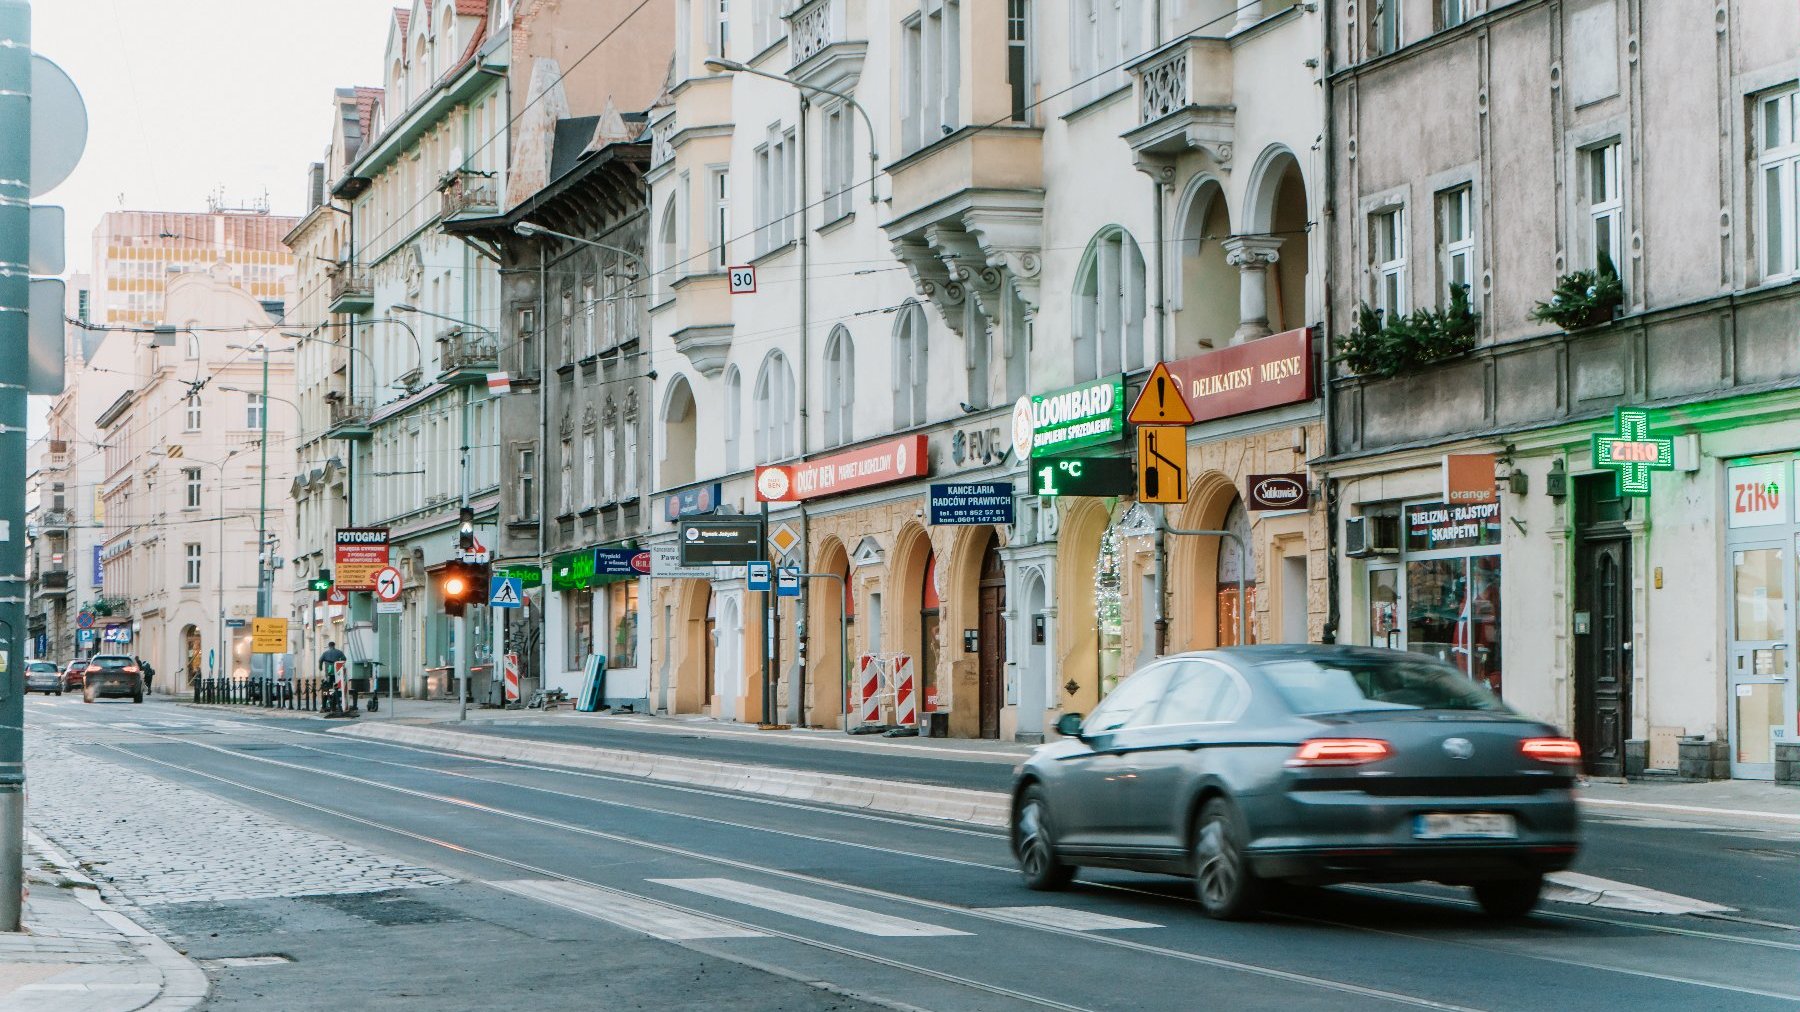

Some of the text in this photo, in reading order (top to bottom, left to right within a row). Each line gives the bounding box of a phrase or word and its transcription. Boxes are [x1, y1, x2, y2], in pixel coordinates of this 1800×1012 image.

[733, 273, 752, 287] 30
[1192, 356, 1301, 399] DELIKATESY MIĘSNE
[1033, 383, 1112, 429] LOOMBARD
[797, 464, 818, 493] DUŻY
[820, 464, 835, 488] BEN
[1039, 466, 1058, 495] 1
[947, 485, 995, 495] KANCELARIA
[1450, 489, 1491, 501] orange
[932, 496, 1011, 507] RADCÓW PRAWNYCH
[1411, 503, 1500, 526] BIELIZNA RAJSTOPY
[337, 531, 387, 543] FOTOGRAF
[1431, 523, 1479, 542] SKARPETKI
